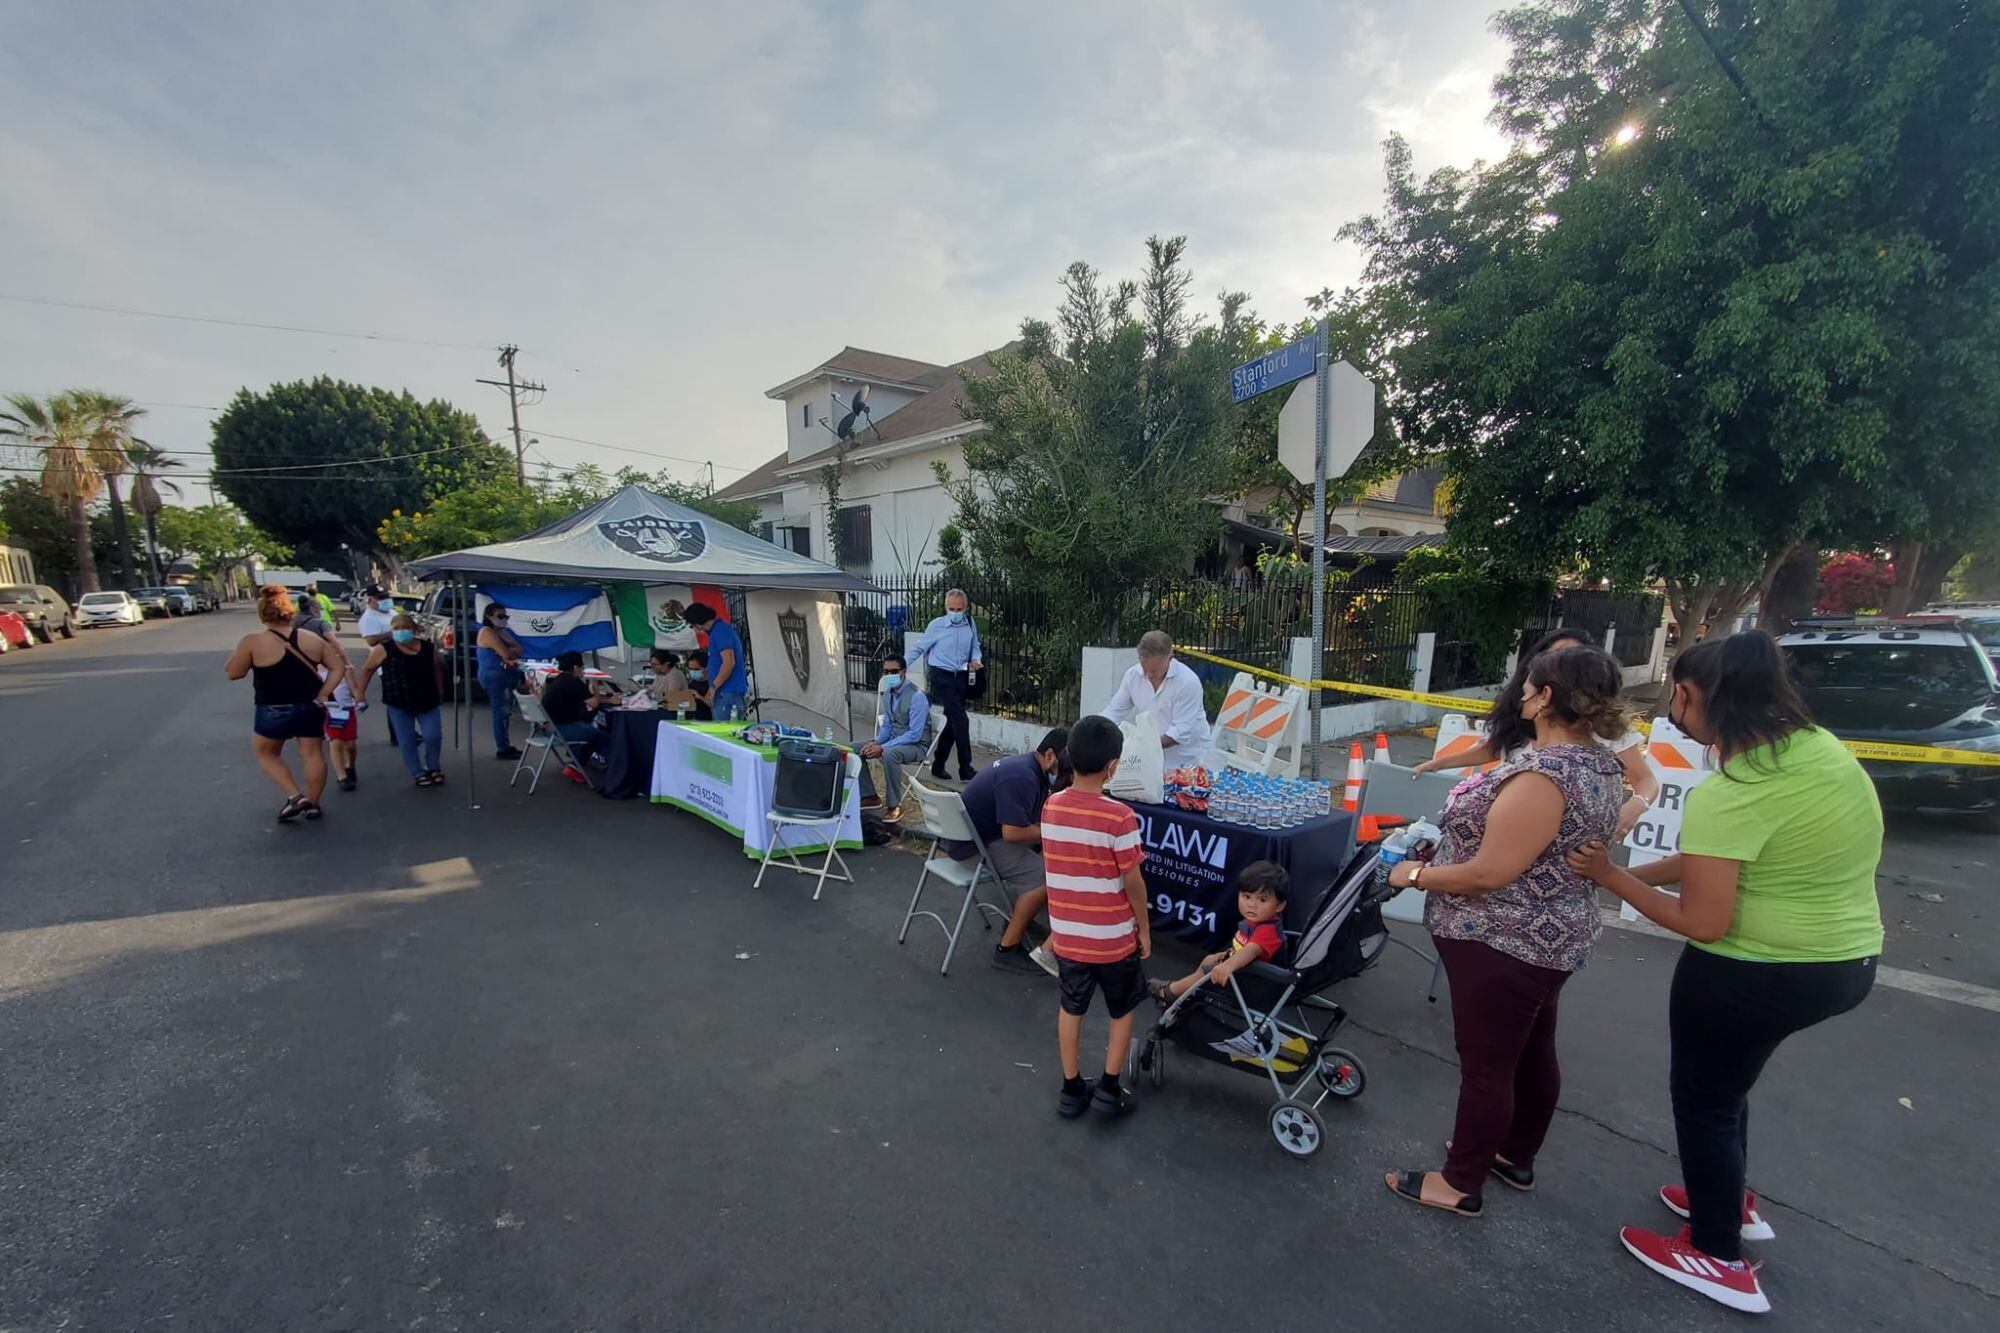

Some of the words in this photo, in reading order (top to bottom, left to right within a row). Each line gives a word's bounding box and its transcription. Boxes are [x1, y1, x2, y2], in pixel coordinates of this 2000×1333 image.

[1233, 351, 1289, 388] Stanford
[1298, 342, 1310, 357] Av
[1235, 382, 1257, 400] 2700
[1261, 376, 1268, 389] S
[609, 520, 692, 529] RAIDERS
[1632, 821, 1681, 851] CL
[1145, 863, 1200, 887] LESIONES
[1164, 857, 1173, 867] IN
[1175, 862, 1225, 883] LITIGATION
